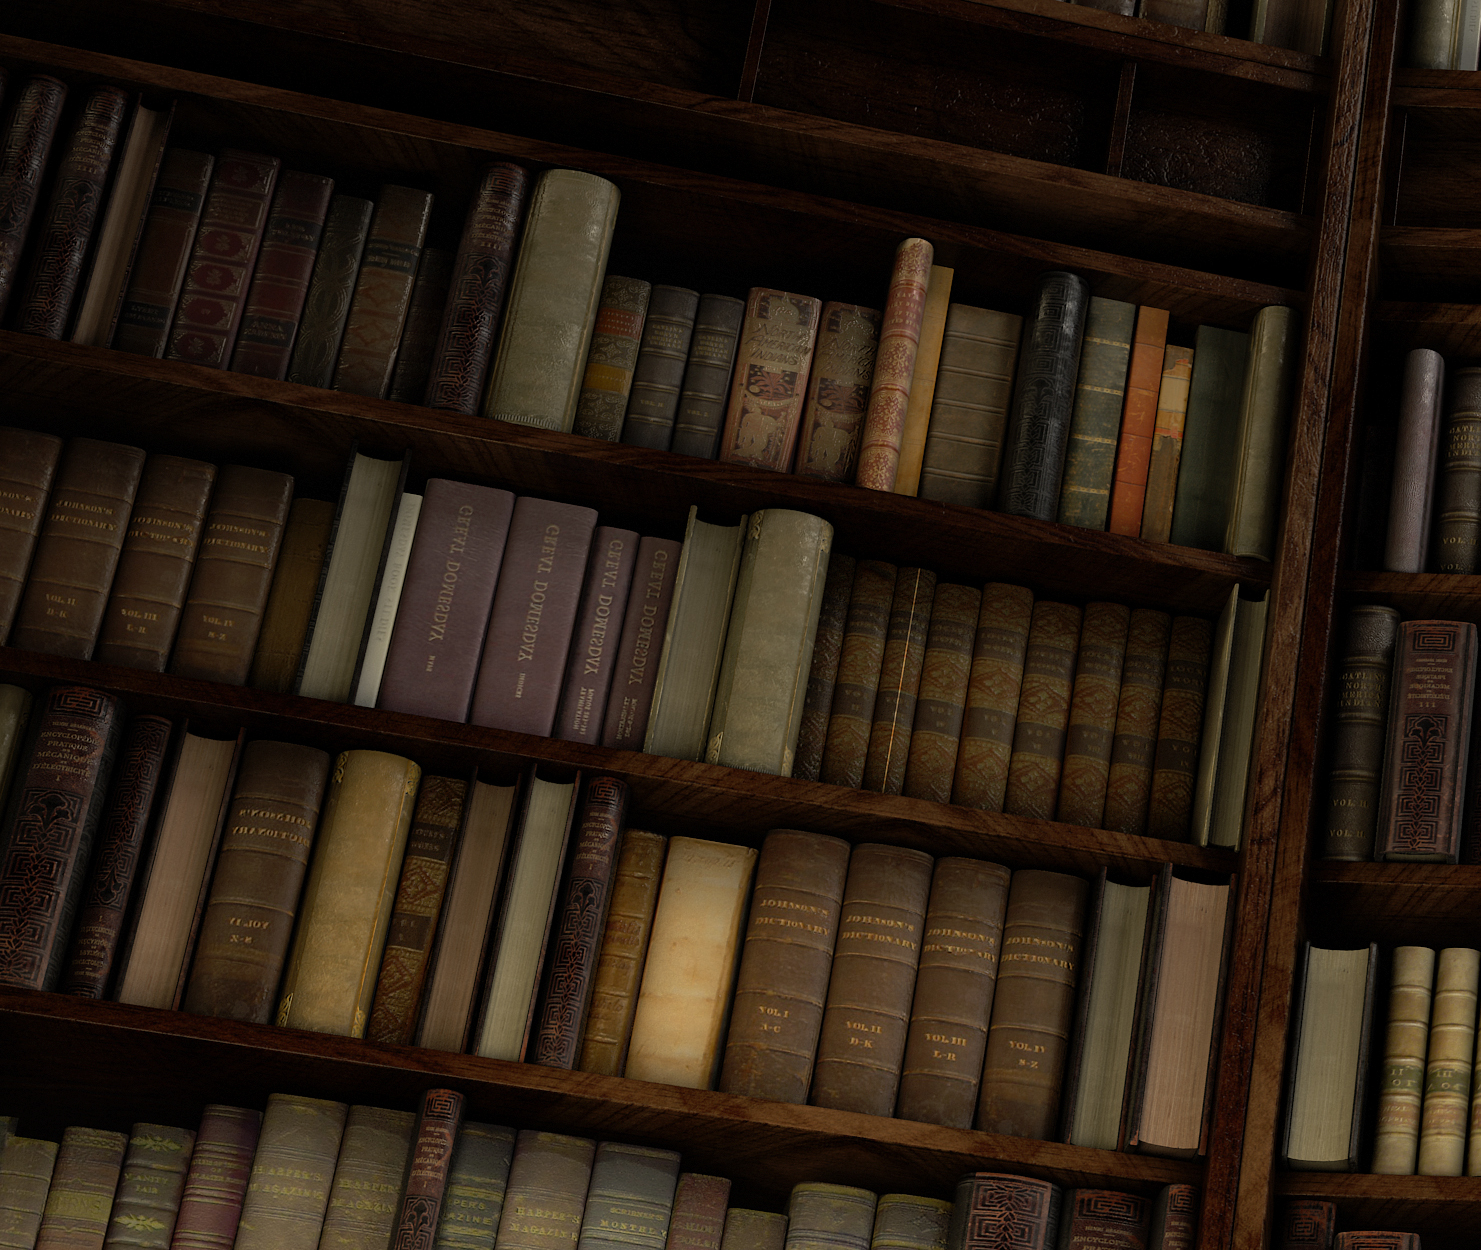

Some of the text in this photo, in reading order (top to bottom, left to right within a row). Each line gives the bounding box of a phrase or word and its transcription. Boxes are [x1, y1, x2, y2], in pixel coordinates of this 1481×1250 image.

[760, 898, 829, 917] JOHNSON'S
[755, 917, 829, 936] DICTIONARY
[845, 914, 915, 933] JOHNSON'S
[841, 931, 917, 951] DICTIONARY
[1005, 937, 1075, 953] JOHNSON'S
[1001, 953, 1075, 970] DICTIONARY
